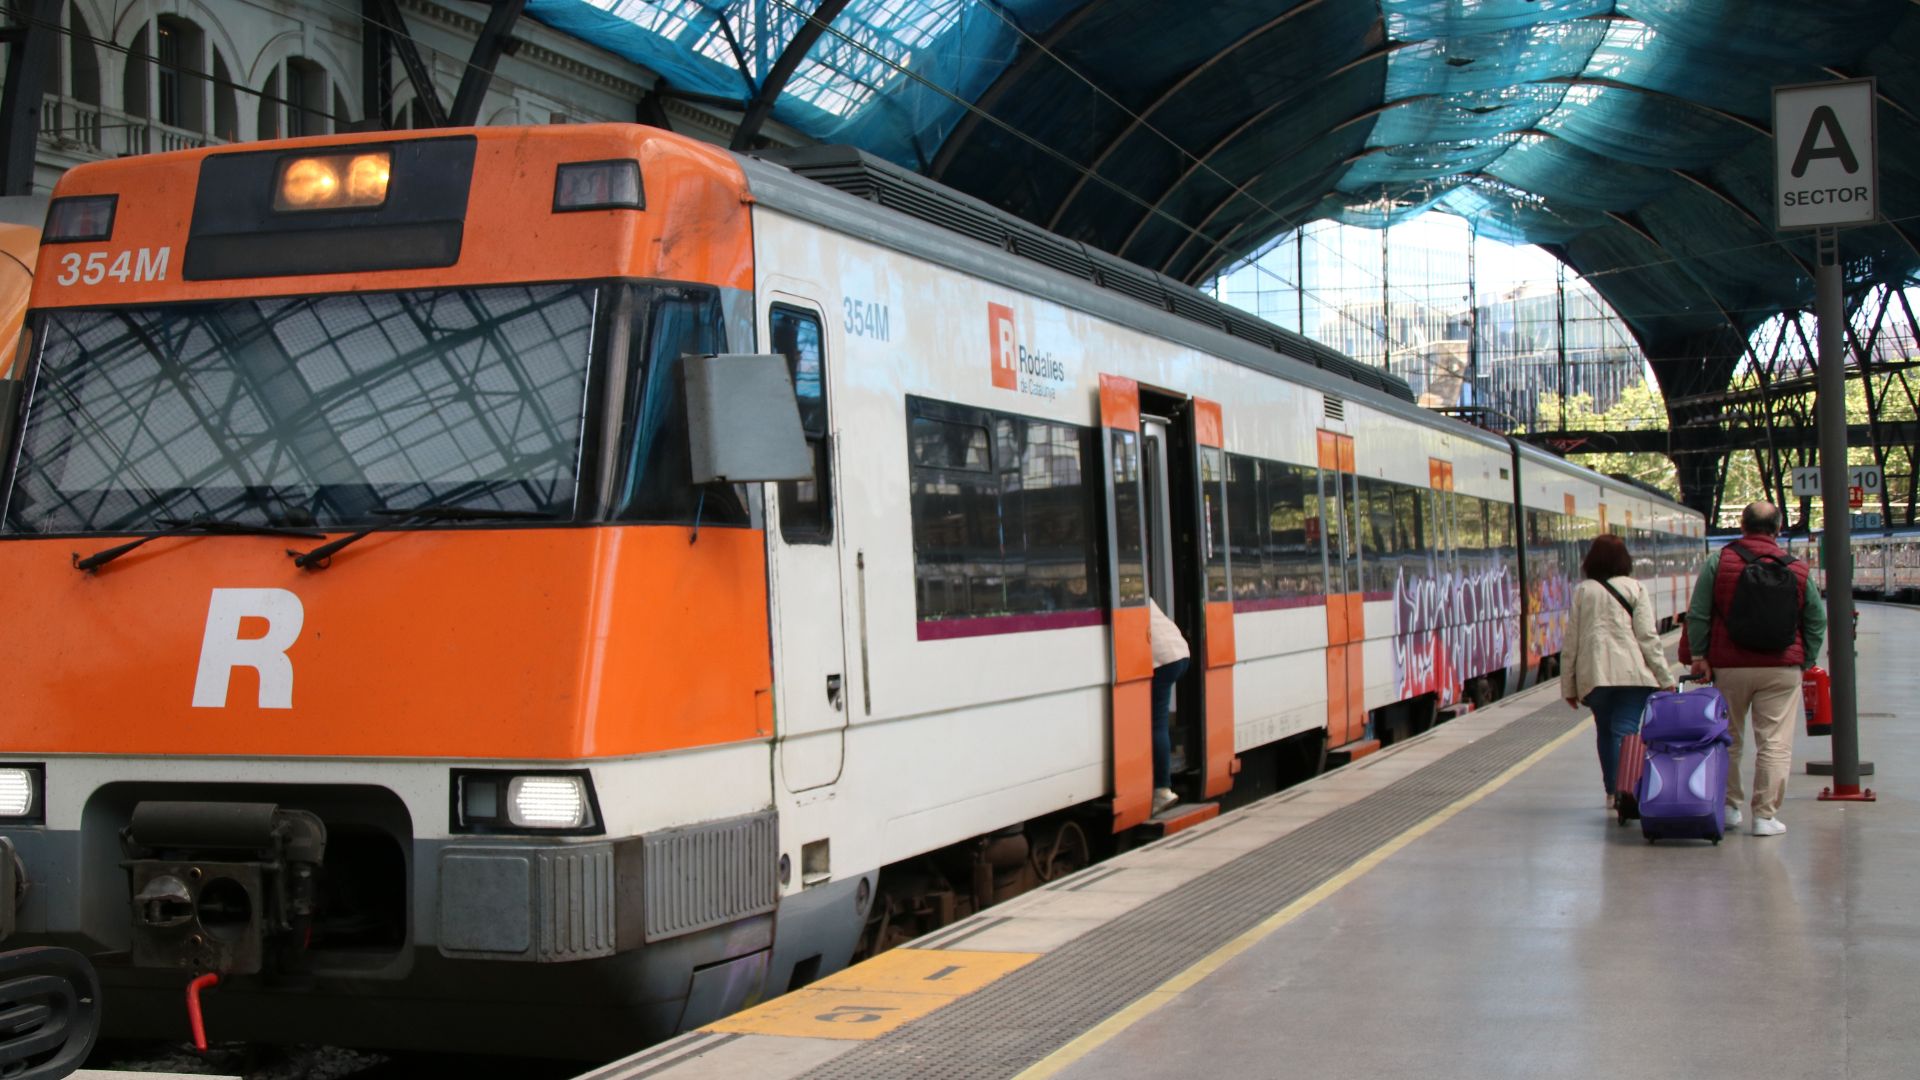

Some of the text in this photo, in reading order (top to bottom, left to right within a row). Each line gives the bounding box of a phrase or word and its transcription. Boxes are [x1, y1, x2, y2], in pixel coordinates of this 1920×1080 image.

[1791, 105, 1859, 178] A
[1784, 186, 1868, 207] SECTOR
[57, 246, 171, 286] 354M
[843, 295, 890, 342] 354M
[998, 318, 1017, 372] R
[1019, 344, 1065, 382] Rodalies
[1020, 377, 1028, 393] de
[1797, 472, 1819, 489] 11
[1853, 471, 1878, 488] 10
[191, 587, 305, 709] R
